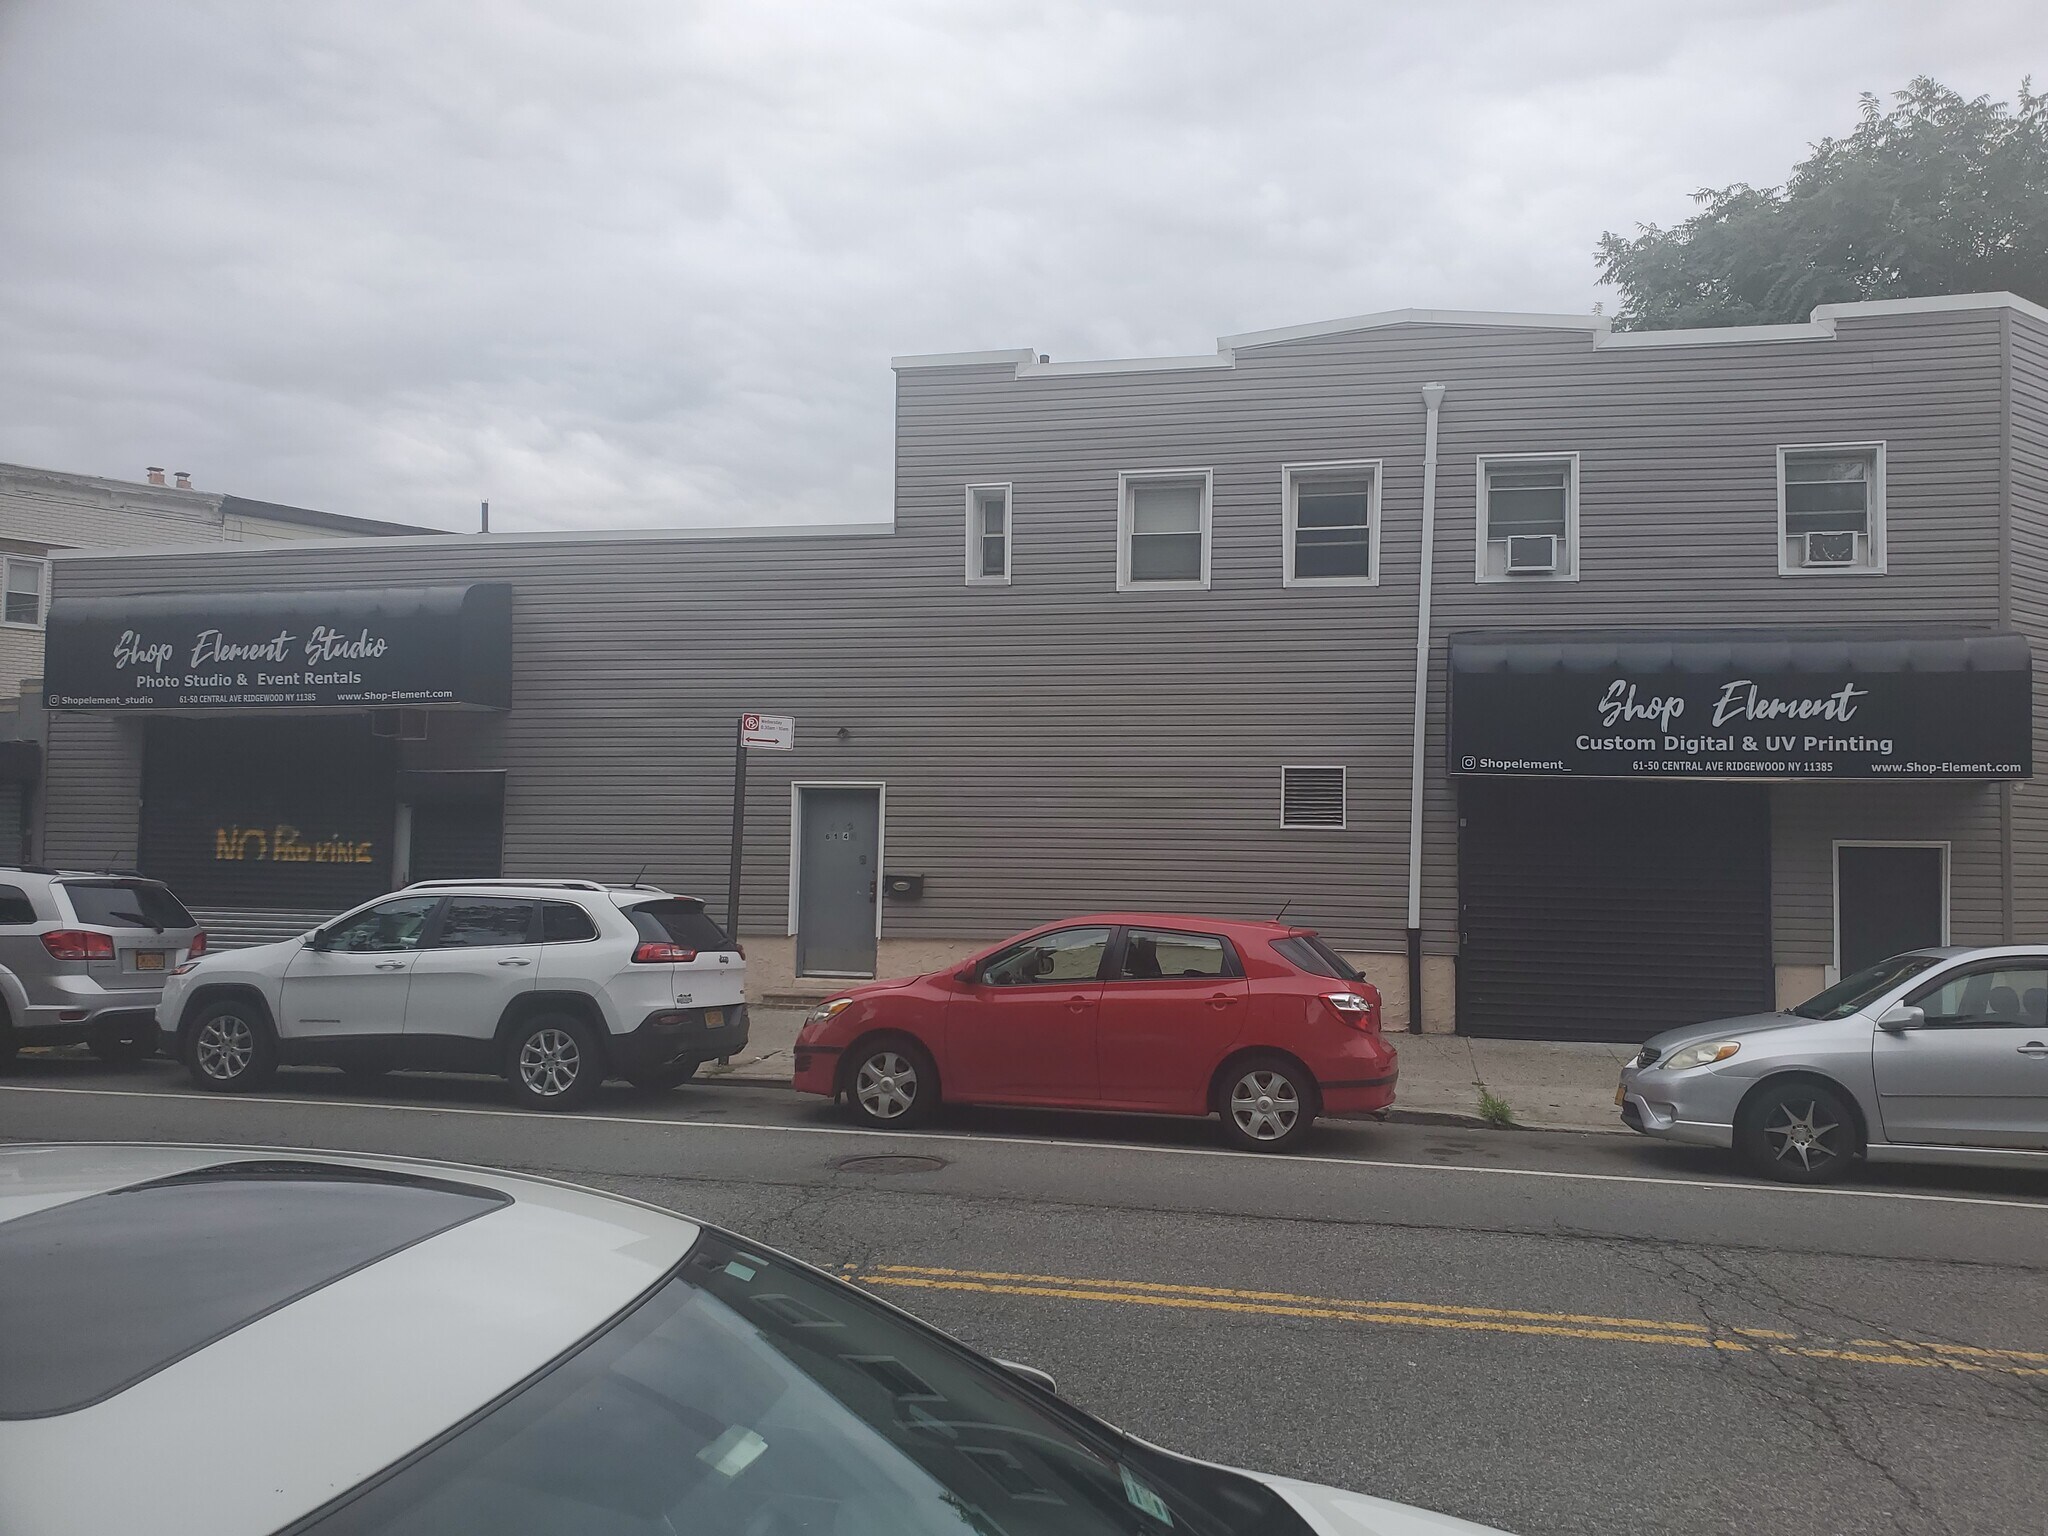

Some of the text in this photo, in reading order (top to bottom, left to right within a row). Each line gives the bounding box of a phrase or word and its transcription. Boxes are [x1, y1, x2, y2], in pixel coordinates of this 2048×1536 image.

[113, 625, 389, 673] Shop Element Studio
[136, 670, 362, 688] Photo Studio & Event Rentals
[61, 694, 154, 706] Shopelement_studio
[179, 693, 317, 704] 61-50 CENTRAL AVE RIDGEWOOD NY 11385
[337, 689, 453, 702] www.Shop-Element.com
[1598, 679, 1869, 733] Shop Element
[1576, 733, 1893, 755] Custom Digital & UV Printing
[1479, 757, 1572, 772] Shopelement_
[1632, 761, 1833, 772] 61-50 CENTRAL AVE RIDGEWOOD NY 11385
[1871, 761, 2022, 774] www.Shop-Element.com
[216, 825, 267, 860] NO
